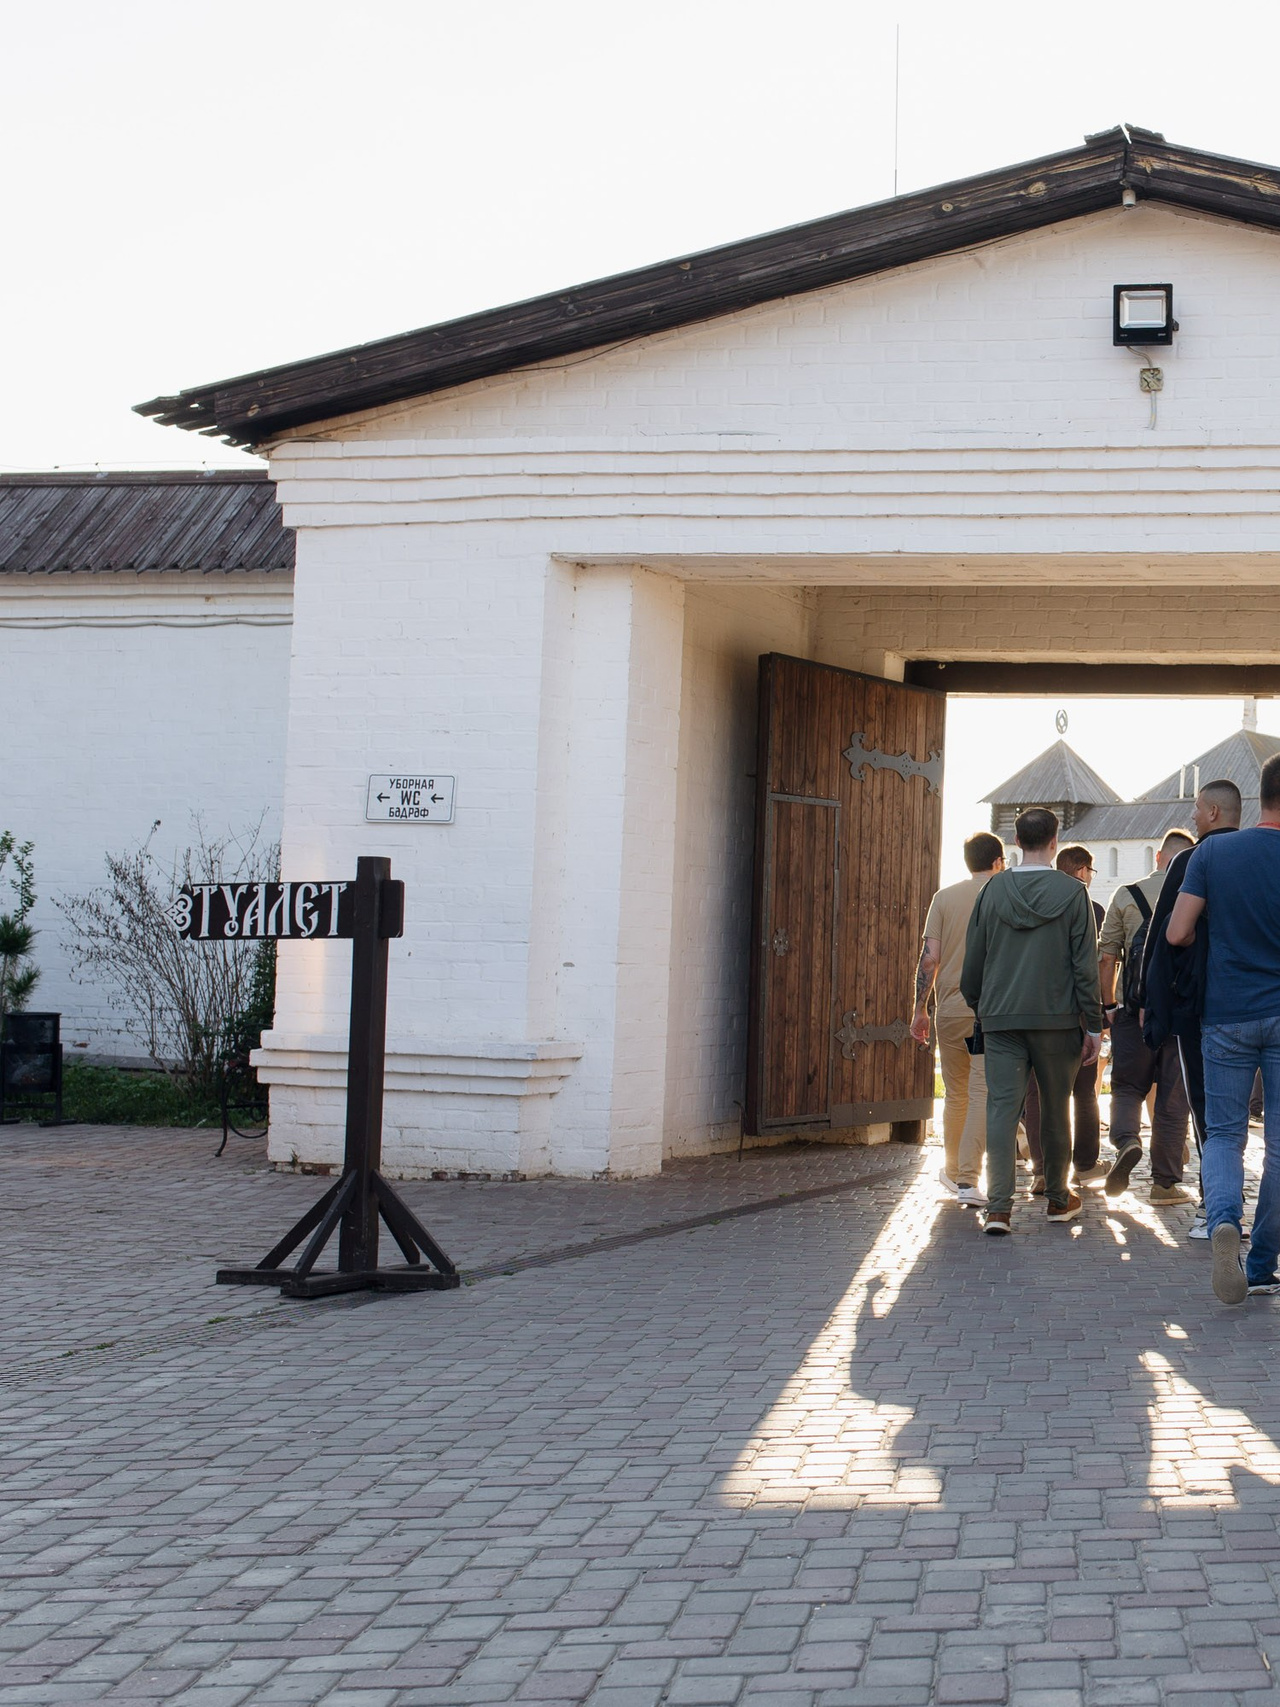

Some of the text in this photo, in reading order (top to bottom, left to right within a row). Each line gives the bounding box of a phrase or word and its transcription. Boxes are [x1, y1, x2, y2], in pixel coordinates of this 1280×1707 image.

[389, 778, 435, 790] УБОРНАЯ
[400, 790, 421, 806] WC
[192, 882, 348, 938] ТУАЛЕТ
